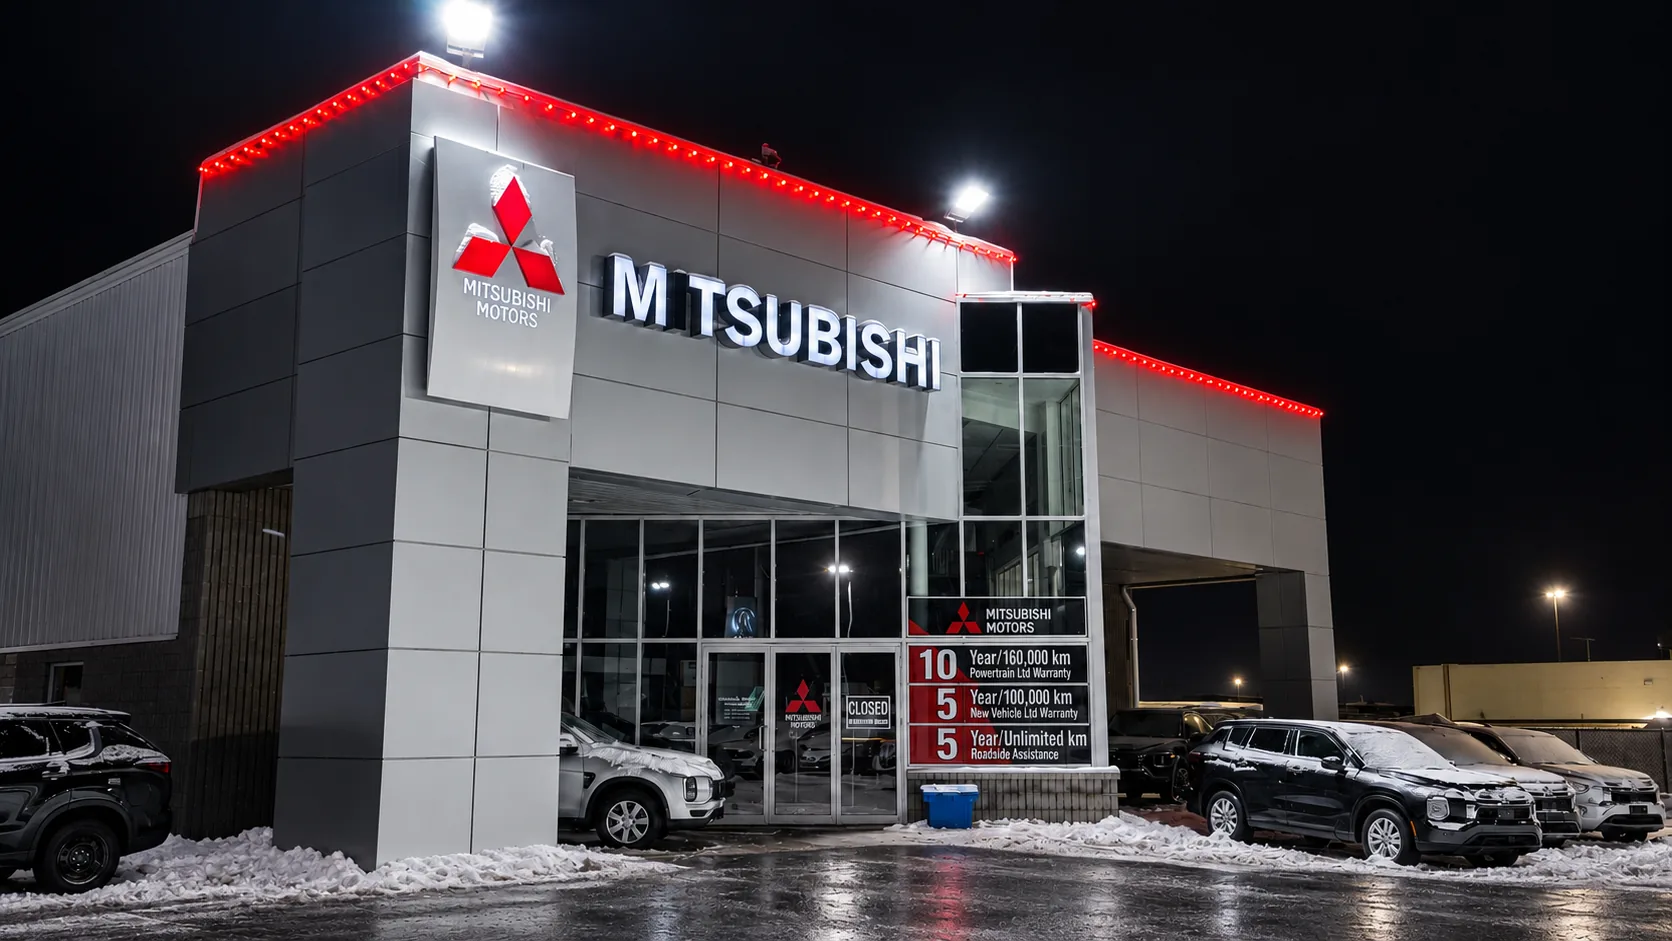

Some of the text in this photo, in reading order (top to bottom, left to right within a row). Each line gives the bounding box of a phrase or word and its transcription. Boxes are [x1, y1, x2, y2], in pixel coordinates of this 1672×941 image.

[463, 277, 551, 313] MITSUBISHI
[476, 300, 538, 328] MOTORS
[985, 608, 1051, 620] MITSUBISHI
[986, 621, 1035, 634] MOTORS
[919, 648, 958, 680] 10
[969, 649, 1071, 668] Year/160,000 km
[969, 667, 1072, 681] Powertrain Ltd Warranty
[936, 687, 957, 720] 5
[970, 689, 1073, 706] Year/100,000 km
[848, 701, 888, 716] CLOSED
[970, 707, 1079, 721] New Vehicle Ltd Warranty
[937, 727, 958, 760] 5
[970, 730, 1087, 747] Year/Unlimited km
[971, 748, 1059, 760] Roadside Assistance
